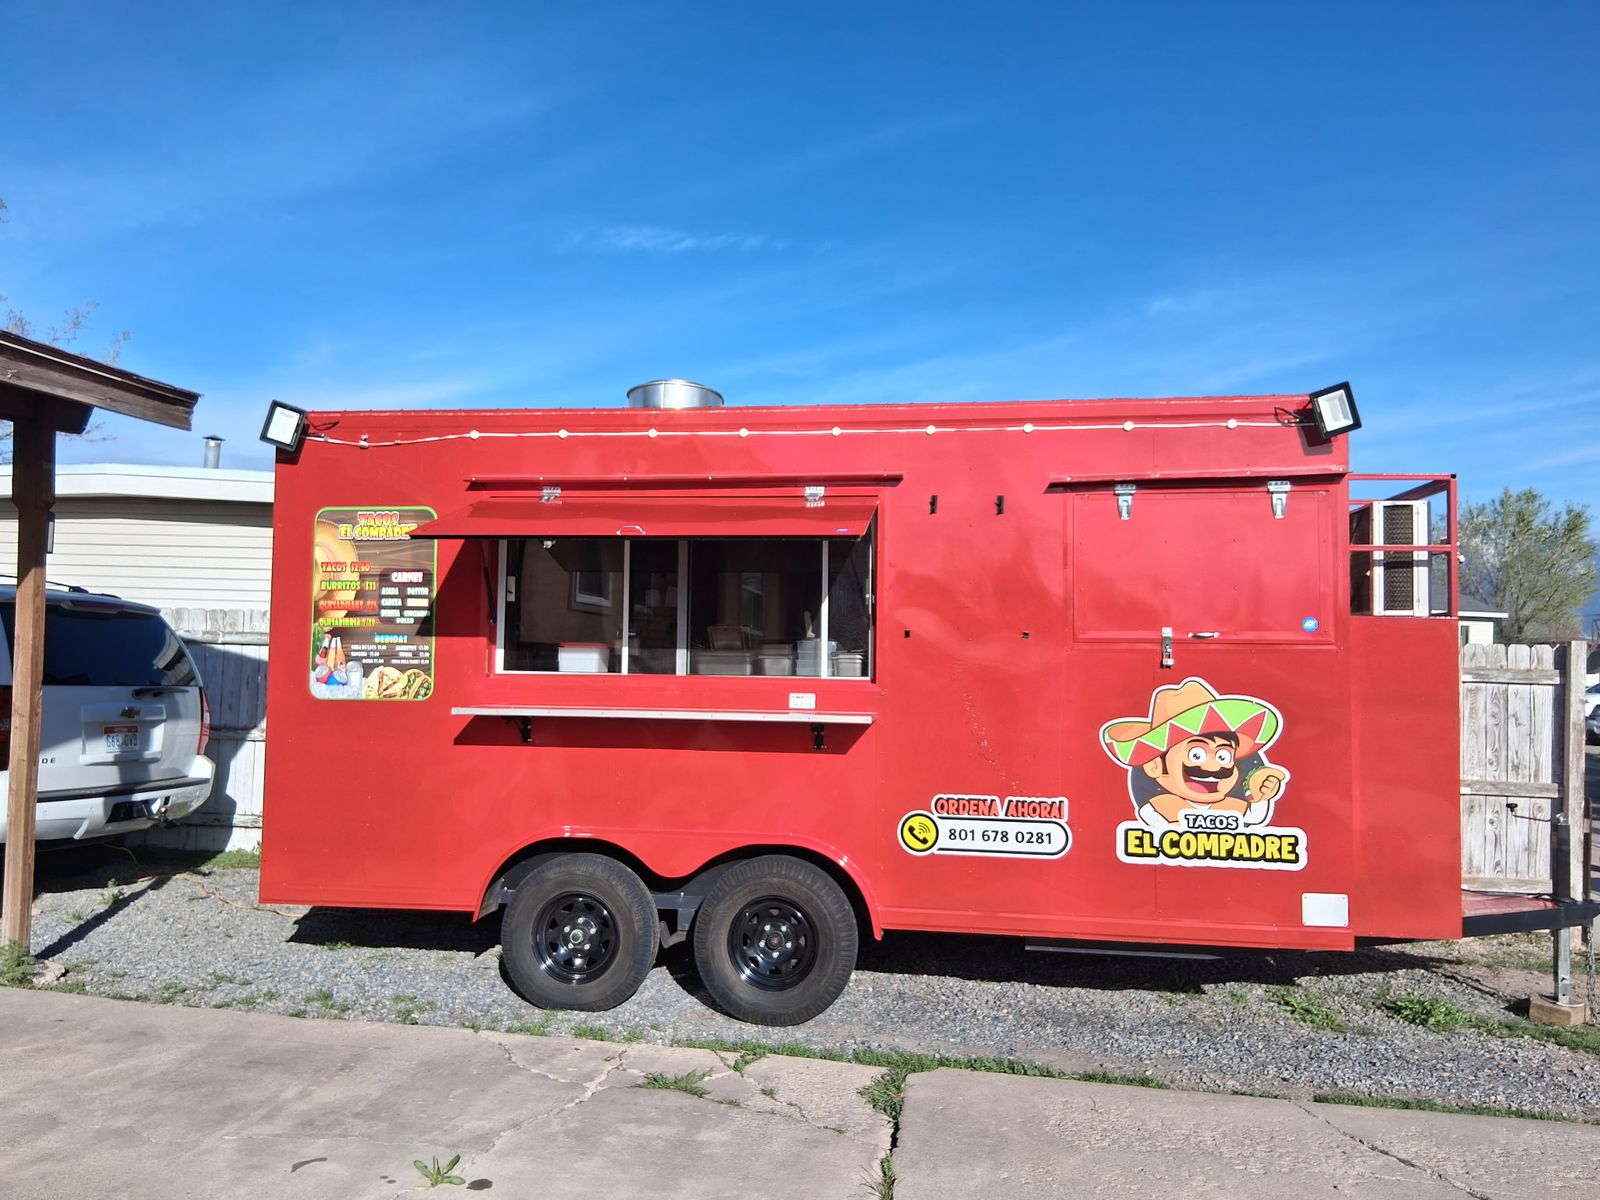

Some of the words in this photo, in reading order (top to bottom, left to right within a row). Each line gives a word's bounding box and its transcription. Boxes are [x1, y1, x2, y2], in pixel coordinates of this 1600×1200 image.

[358, 512, 399, 525] TACOS
[340, 525, 352, 538] EL
[321, 562, 346, 572] TACOS
[320, 581, 360, 590] BURRITOS
[934, 797, 999, 817] ORDENA
[1185, 814, 1239, 830] TACOS
[948, 828, 975, 842] 801
[981, 829, 1009, 844] 678
[1015, 831, 1052, 845] 0281
[1125, 829, 1159, 857] EL
[1159, 830, 1300, 863] COMPADRE
